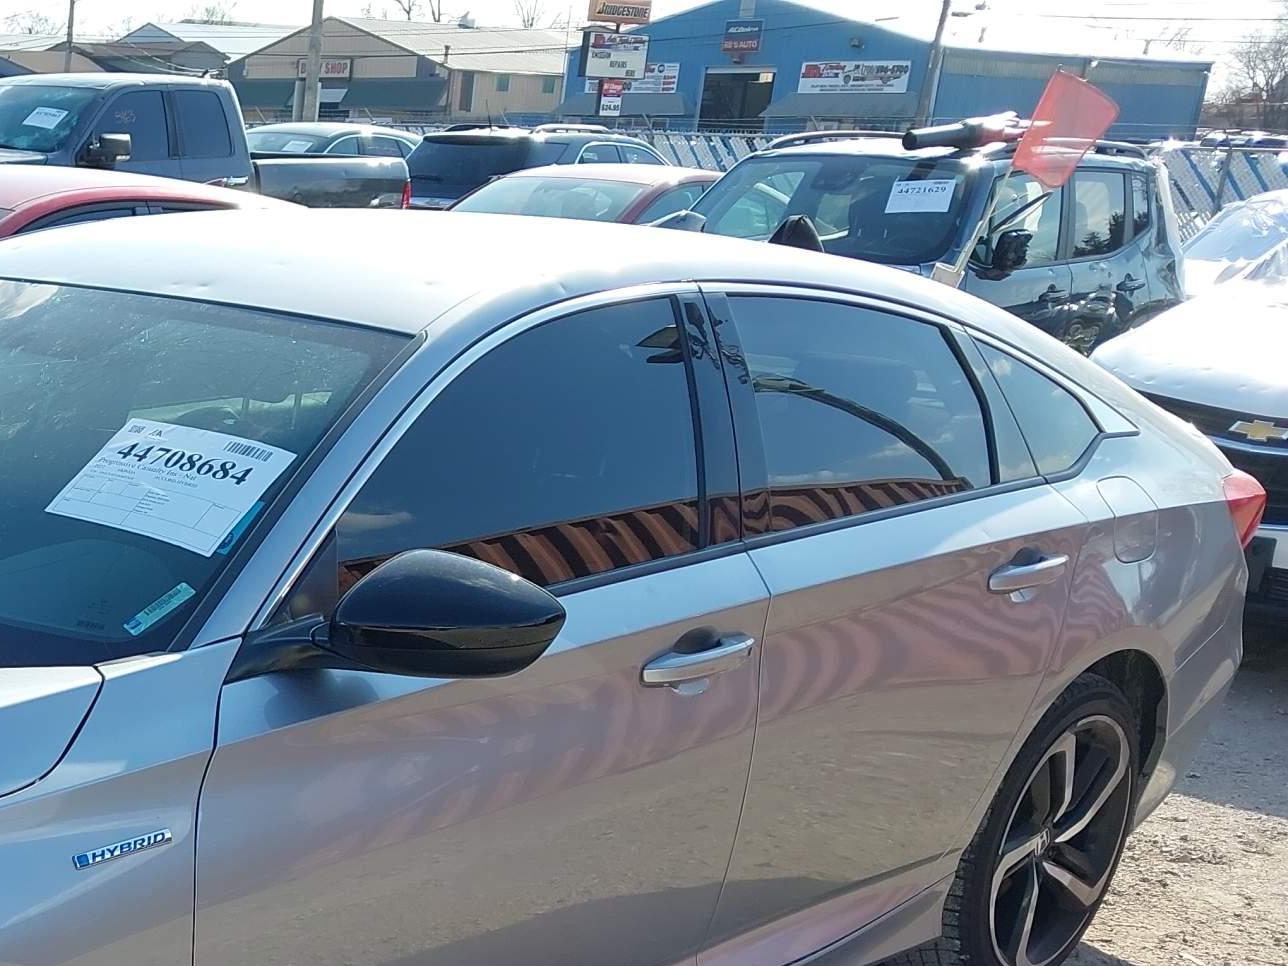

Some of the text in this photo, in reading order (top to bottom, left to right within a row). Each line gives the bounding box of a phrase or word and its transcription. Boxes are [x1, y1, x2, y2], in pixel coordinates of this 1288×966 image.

[597, 2, 650, 19] BRIDGESTONE
[739, 40, 758, 48] AUTO
[324, 62, 348, 74] SHOP
[897, 185, 947, 194] 44721629
[116, 442, 254, 486] 44708684
[92, 832, 166, 863] HYBRID
